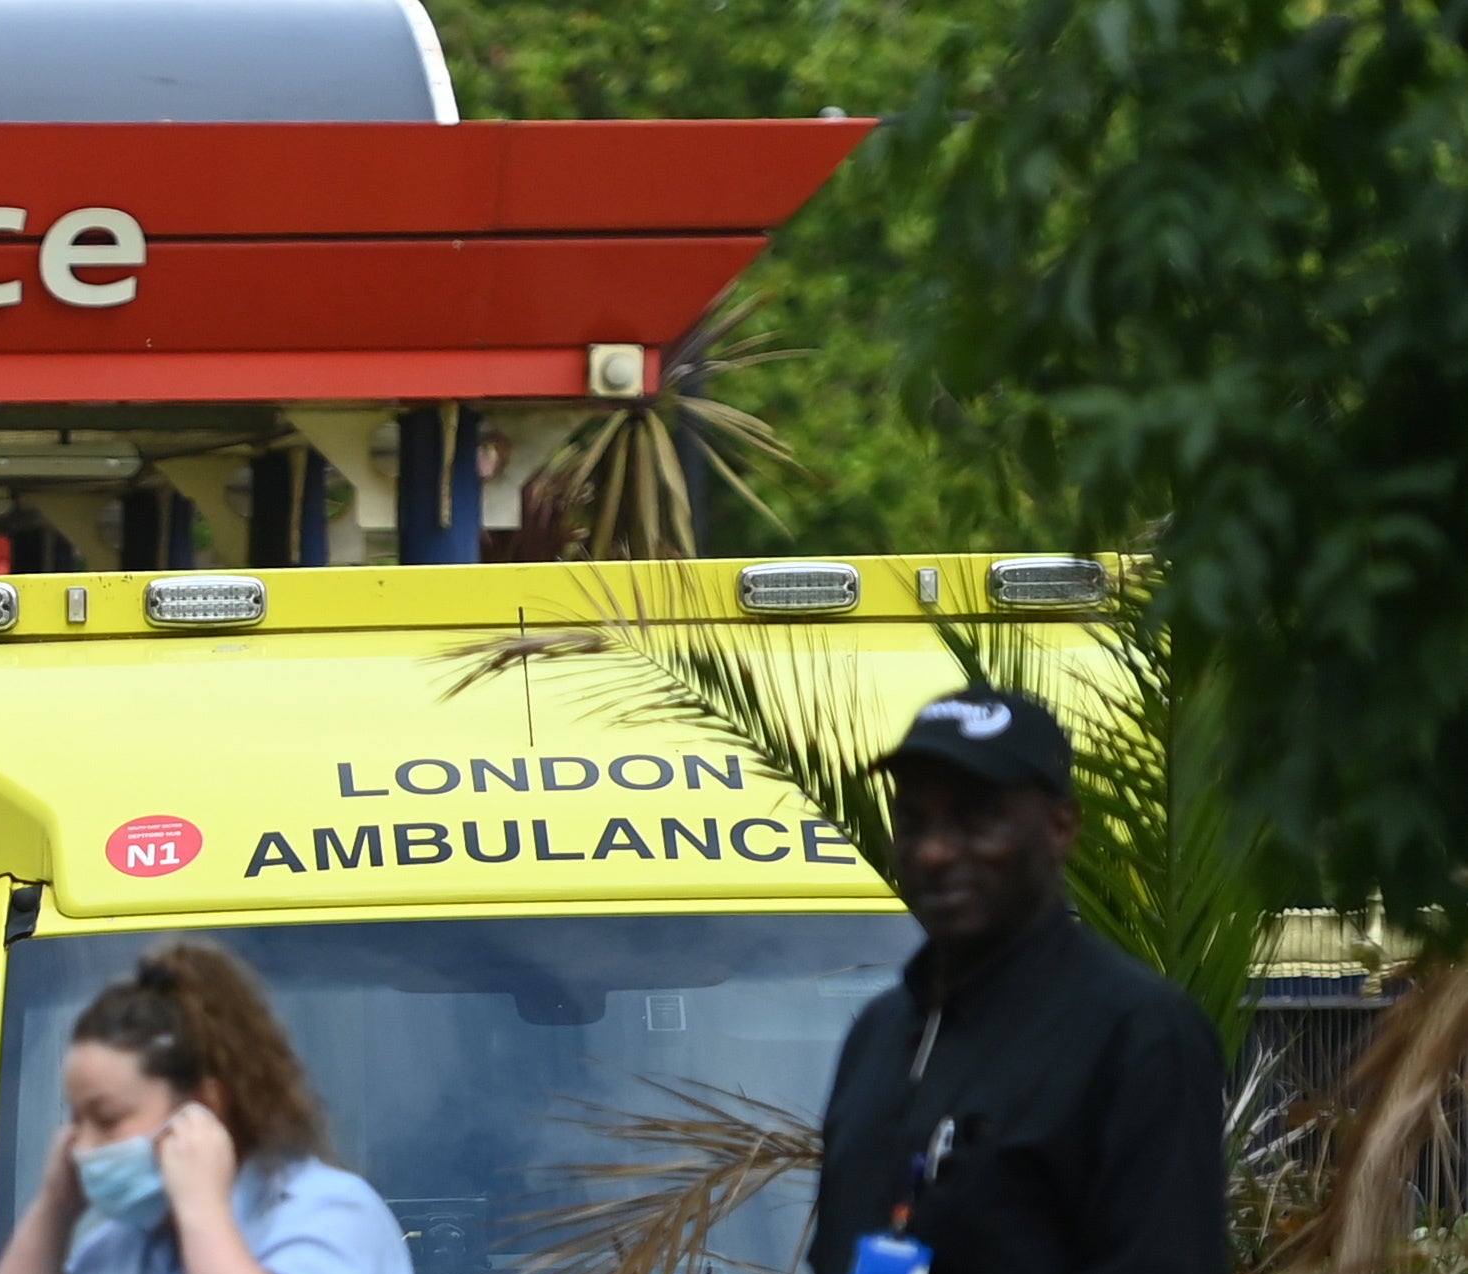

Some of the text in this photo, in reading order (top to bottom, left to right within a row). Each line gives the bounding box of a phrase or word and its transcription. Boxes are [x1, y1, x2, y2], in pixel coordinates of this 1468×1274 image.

[336, 754, 745, 798] LONDON
[127, 841, 180, 868] N1
[244, 817, 857, 878] AMBULANCE
